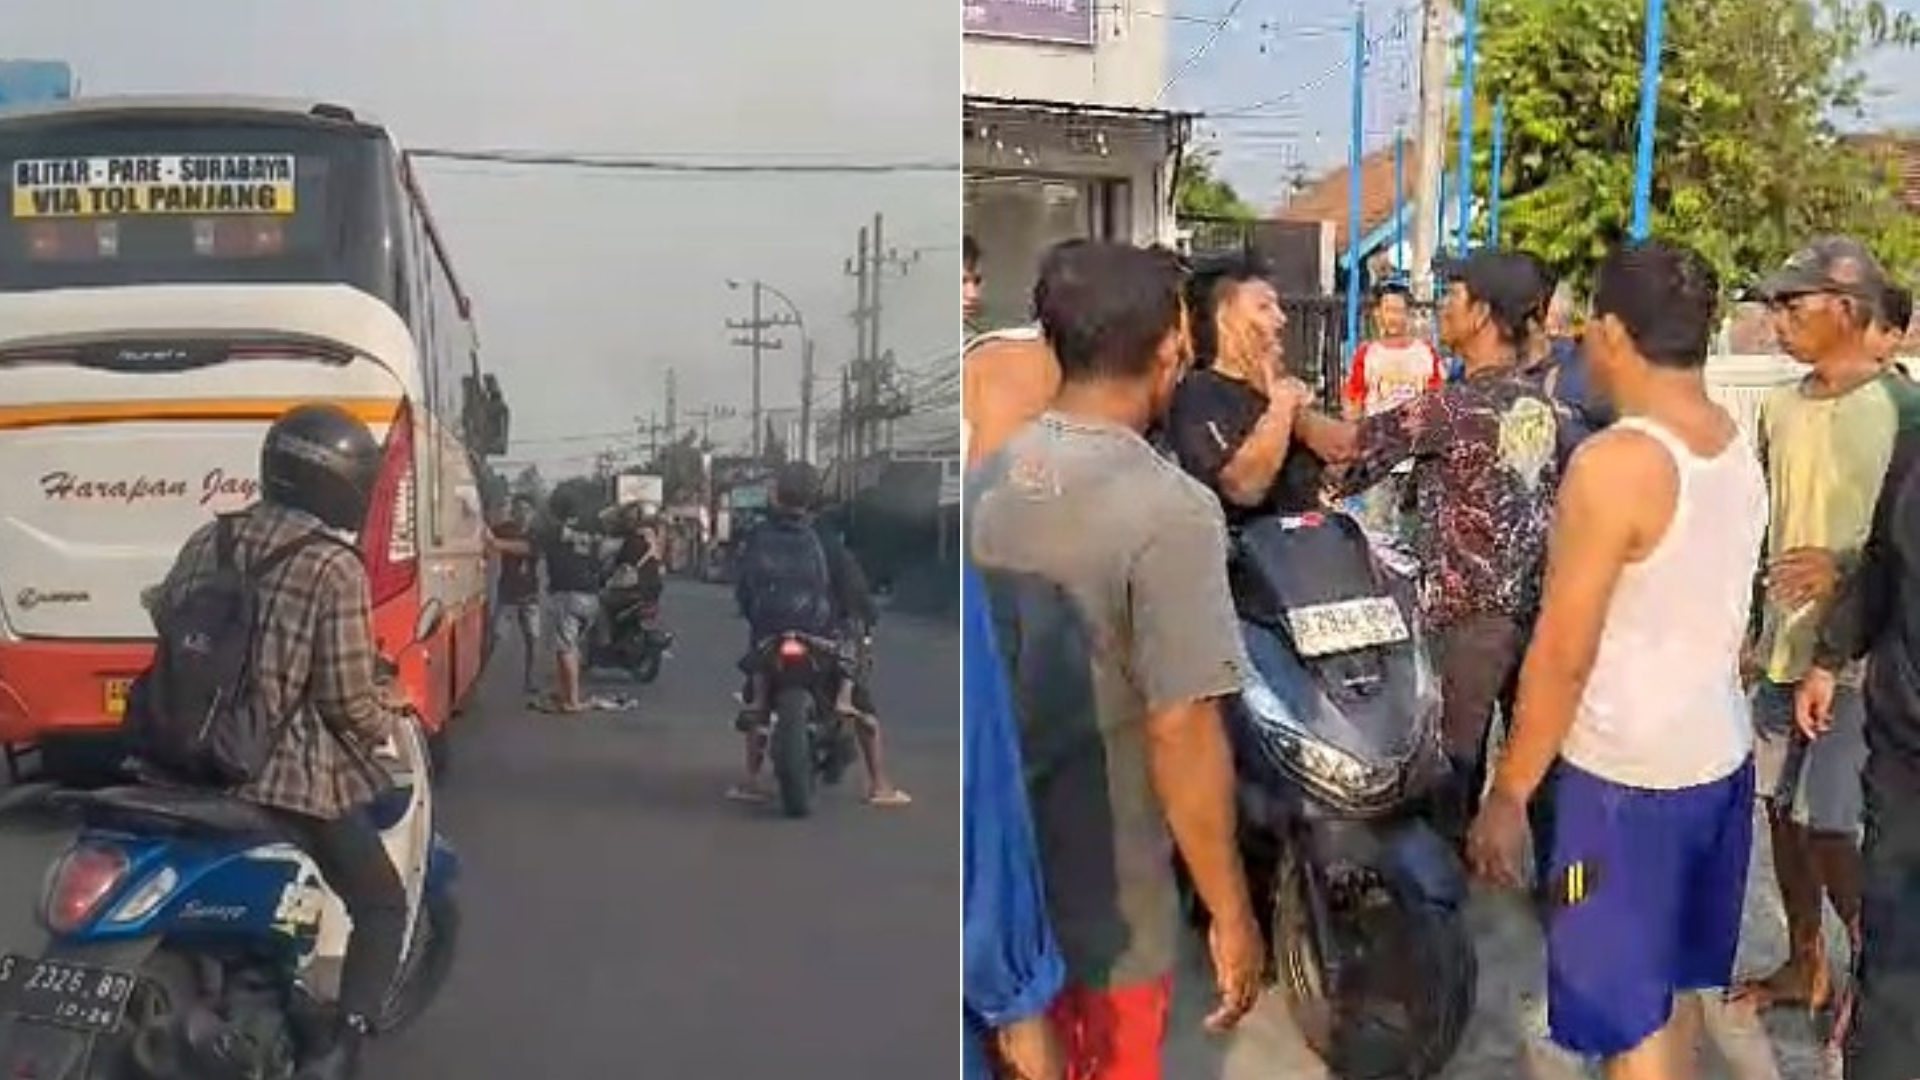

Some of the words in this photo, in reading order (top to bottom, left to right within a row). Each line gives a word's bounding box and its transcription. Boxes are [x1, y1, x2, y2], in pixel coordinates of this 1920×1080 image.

[18, 161, 89, 185] BLITAR
[108, 158, 161, 182] PARE
[179, 157, 288, 181] SURABAYA
[31, 187, 80, 213] VIA
[87, 186, 140, 212] TOL
[149, 183, 276, 211] PANJANG
[40, 471, 187, 503] Harapan
